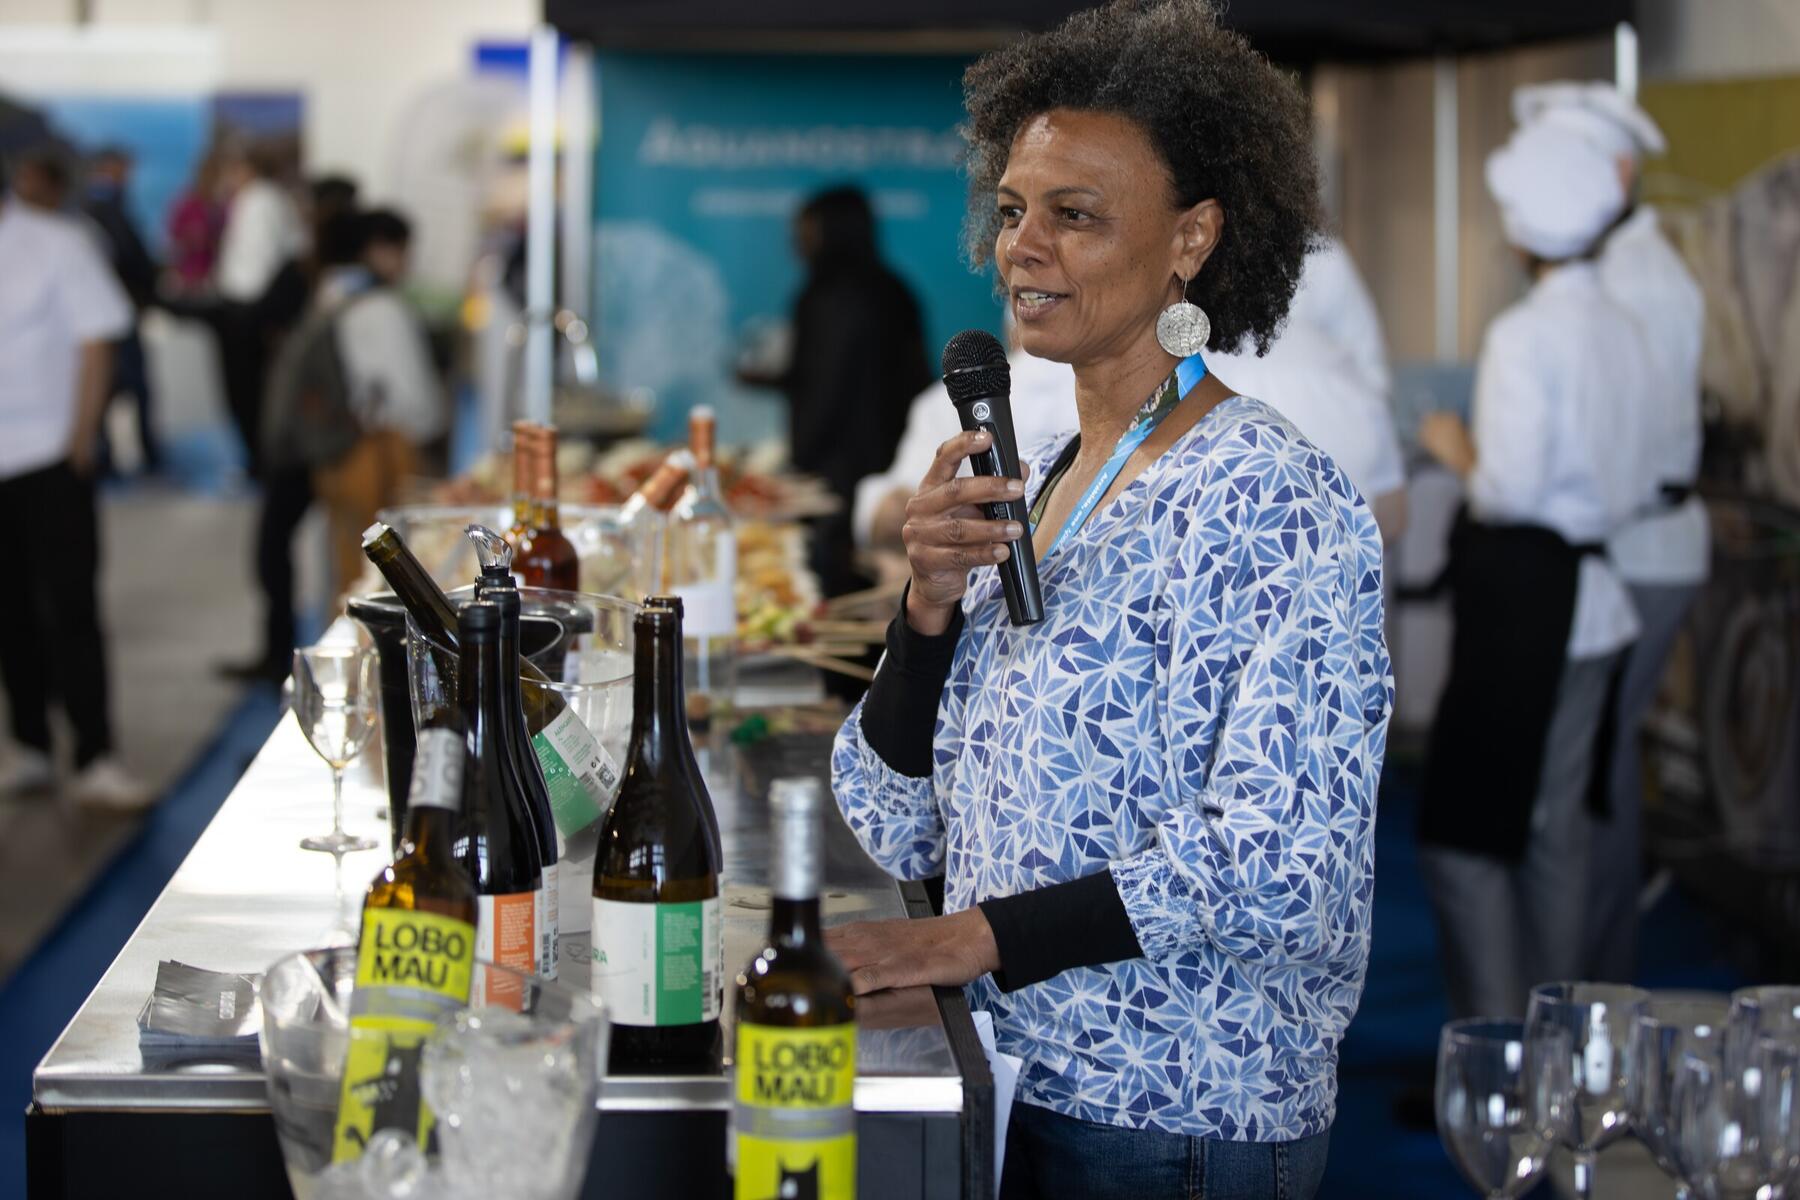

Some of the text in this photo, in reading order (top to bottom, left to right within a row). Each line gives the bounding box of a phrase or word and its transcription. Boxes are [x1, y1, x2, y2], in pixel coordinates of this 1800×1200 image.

[375, 921, 466, 962] LOBO
[372, 953, 448, 989] MAU
[754, 1037, 849, 1072] LOBO
[754, 1074, 836, 1105] MAU
